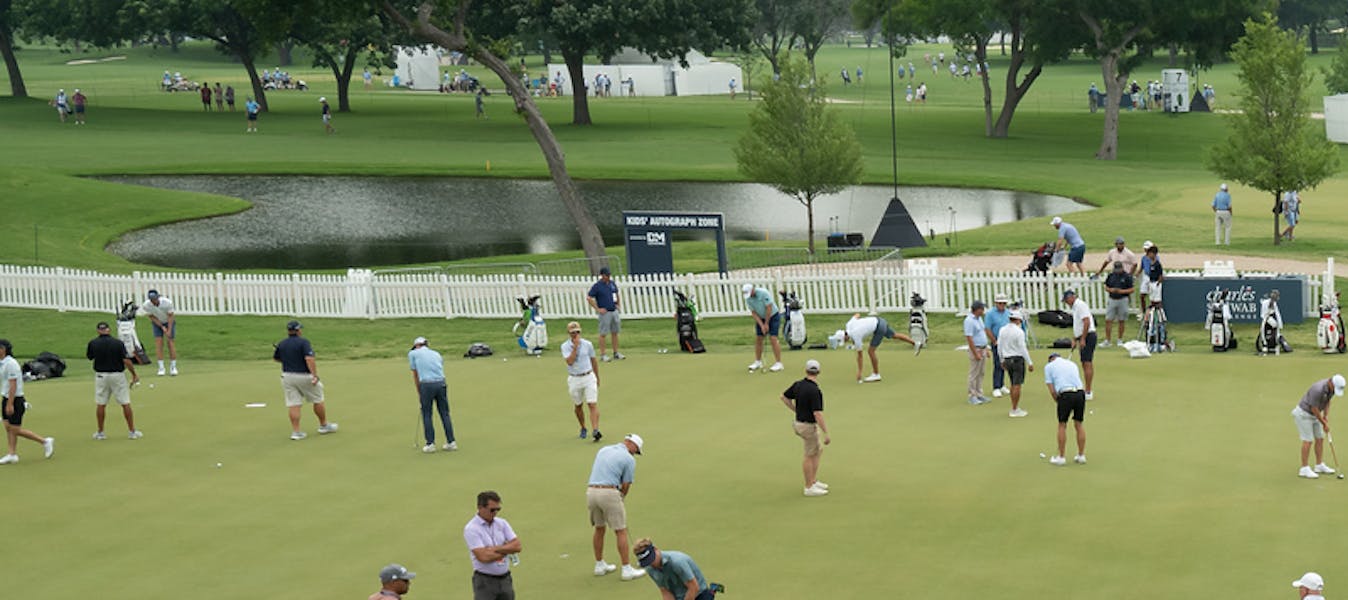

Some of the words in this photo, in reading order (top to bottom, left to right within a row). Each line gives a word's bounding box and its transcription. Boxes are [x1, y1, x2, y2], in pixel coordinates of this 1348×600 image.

[626, 216, 648, 226] KIDS'
[650, 217, 696, 227] AUTOGRAPH
[698, 218, 719, 227] ZONE
